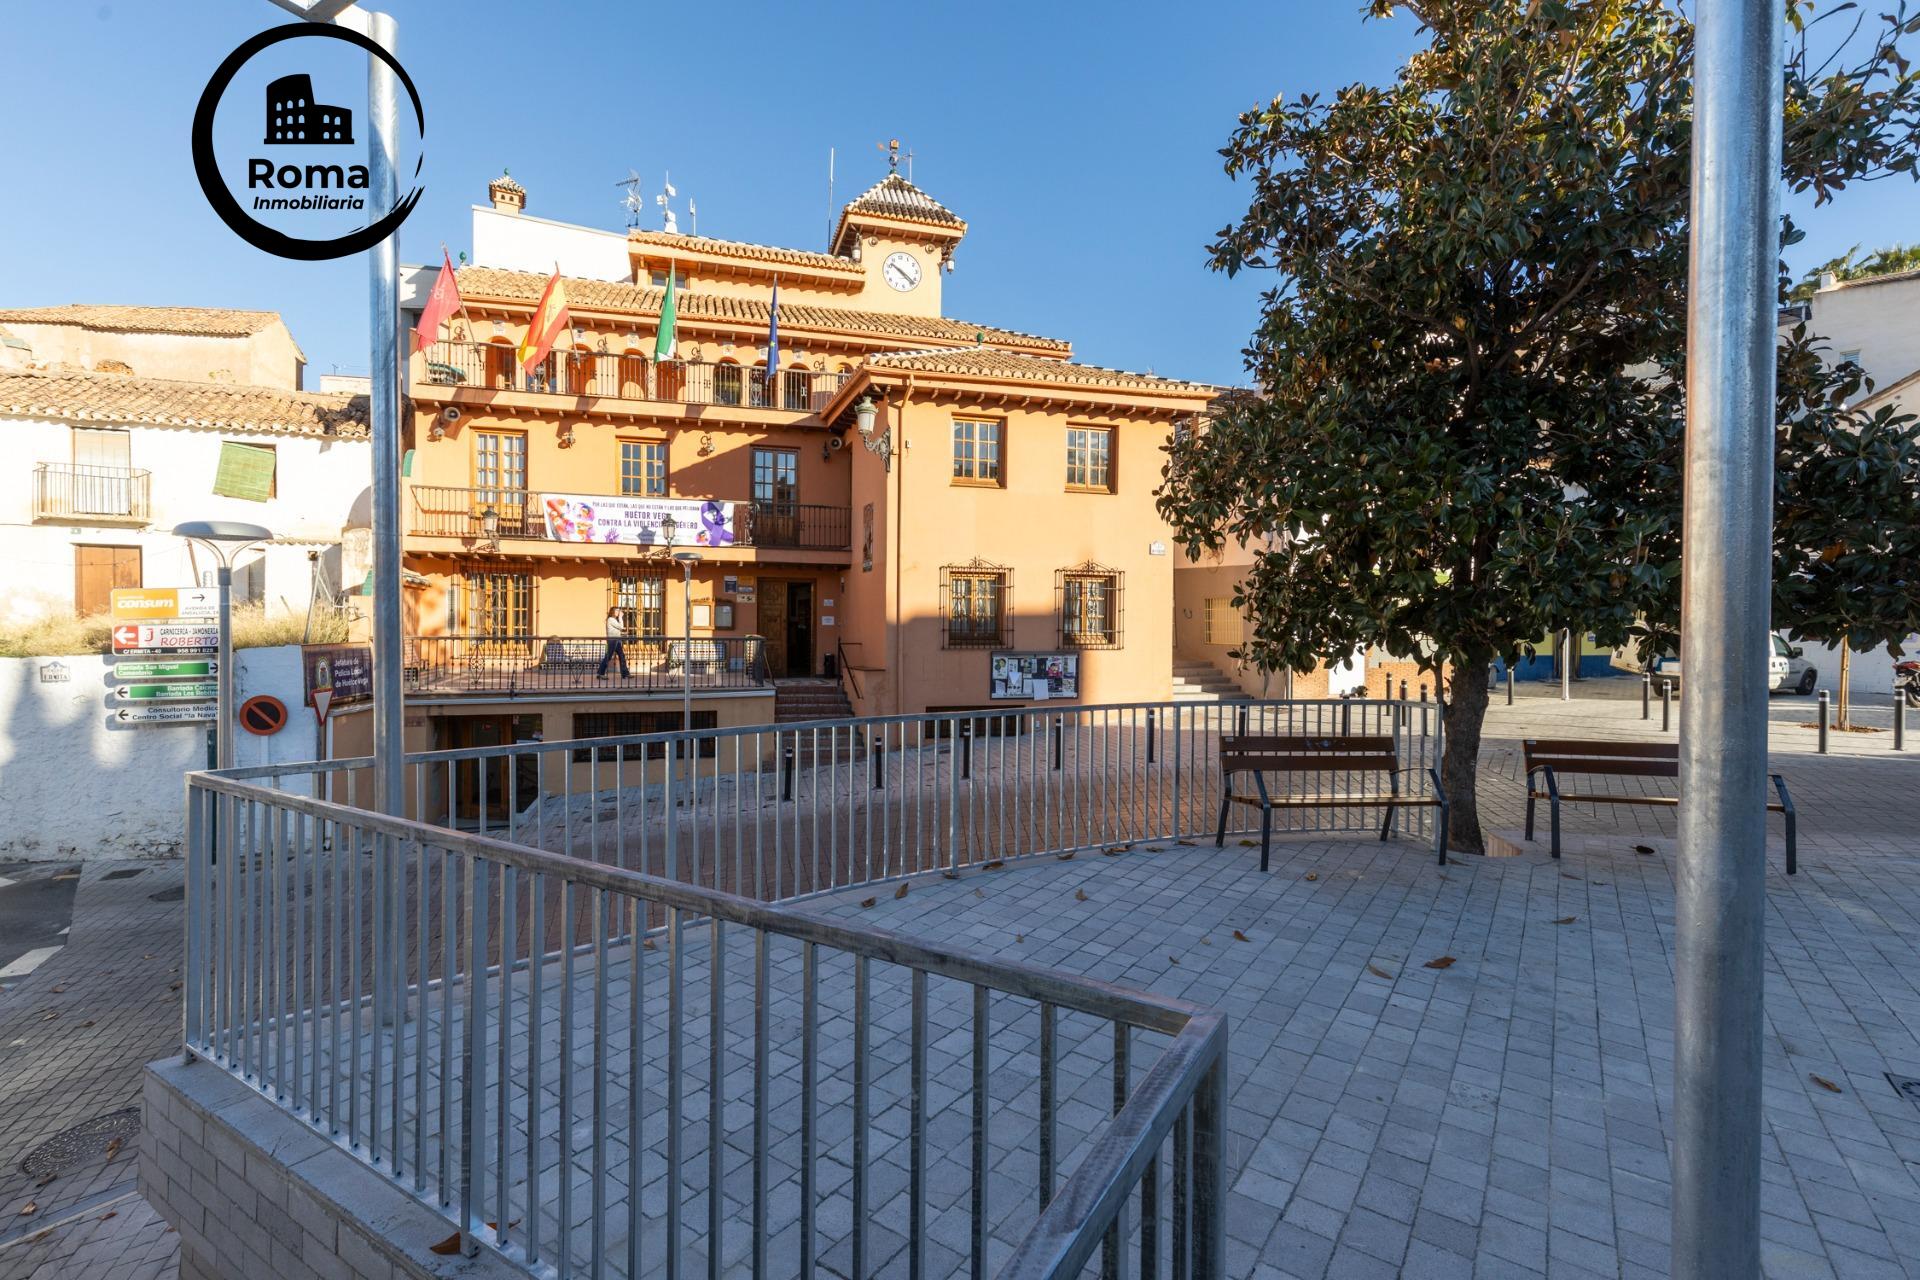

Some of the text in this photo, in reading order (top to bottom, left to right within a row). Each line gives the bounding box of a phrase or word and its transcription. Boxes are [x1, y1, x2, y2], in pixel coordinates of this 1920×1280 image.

[624, 510, 651, 520] HUÉTOR
[598, 518, 622, 526] CONTRA
[623, 519, 632, 527] LA
[160, 636, 219, 646] ROBERTO
[147, 706, 190, 714] Consultorio
[159, 712, 183, 720] Social
